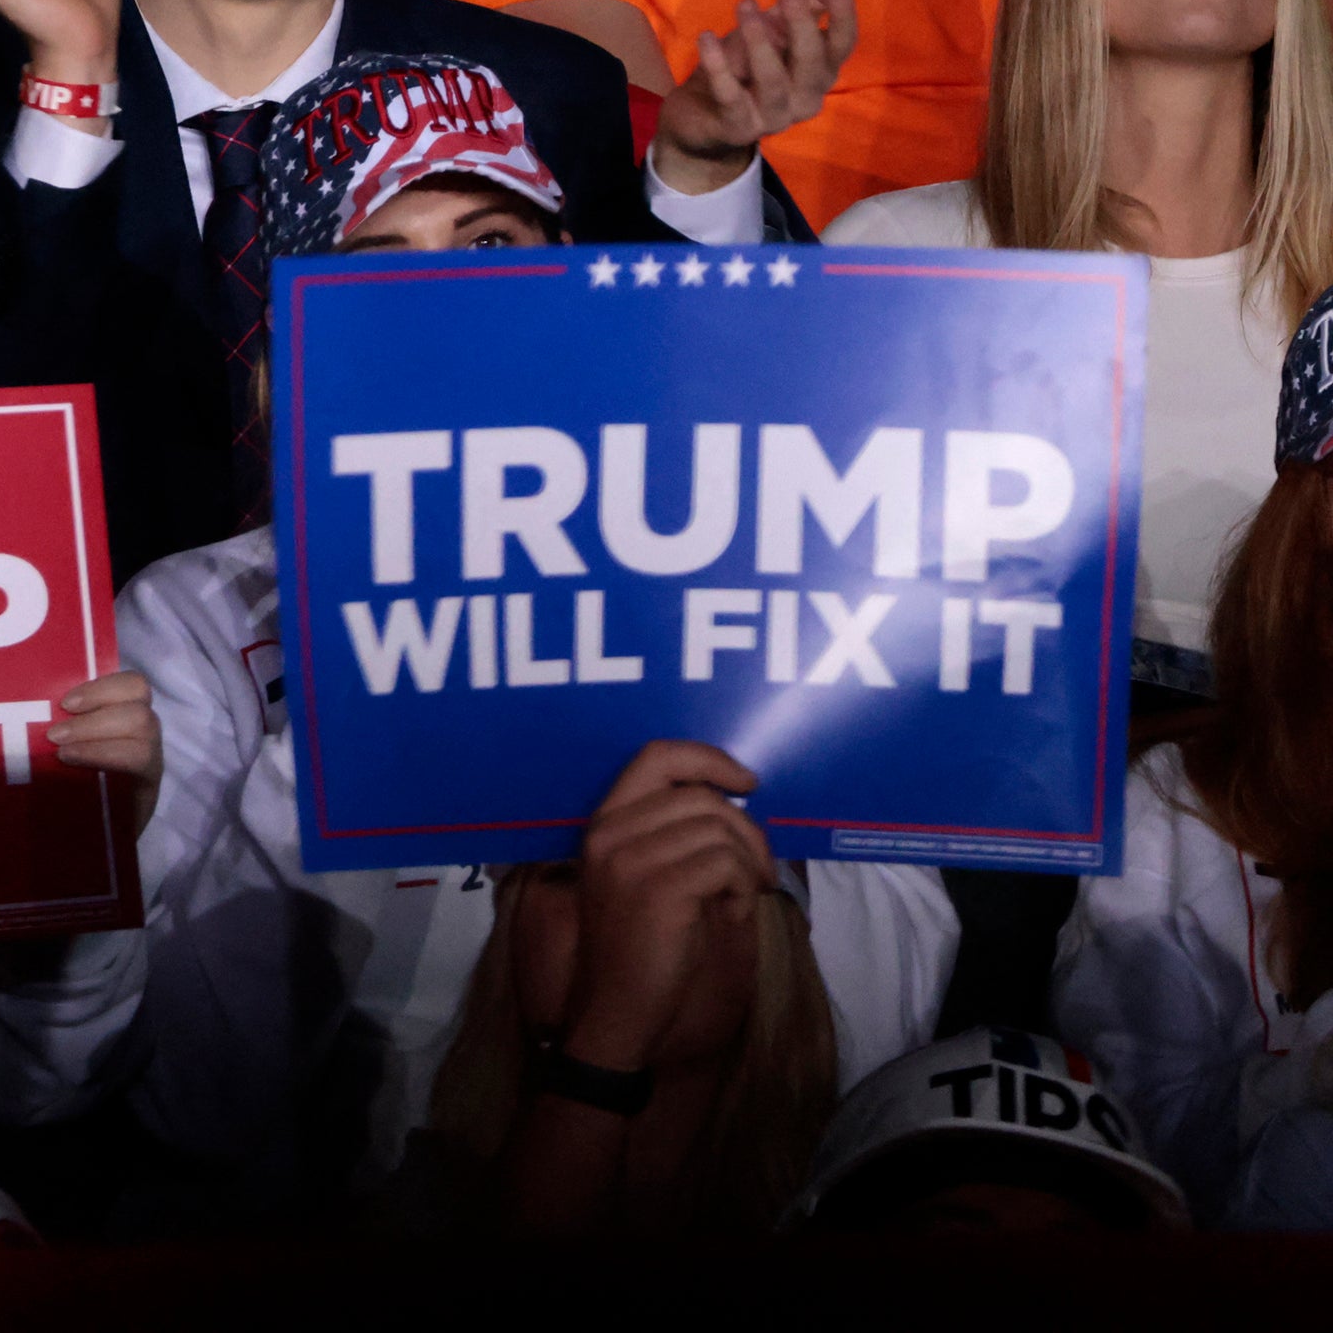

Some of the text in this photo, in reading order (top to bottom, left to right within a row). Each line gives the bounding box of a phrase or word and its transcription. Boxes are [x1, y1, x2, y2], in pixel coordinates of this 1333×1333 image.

[293, 67, 513, 184] TRUMP
[329, 422, 1076, 586] TRUMP
[340, 587, 1065, 697] WILL FIX IT
